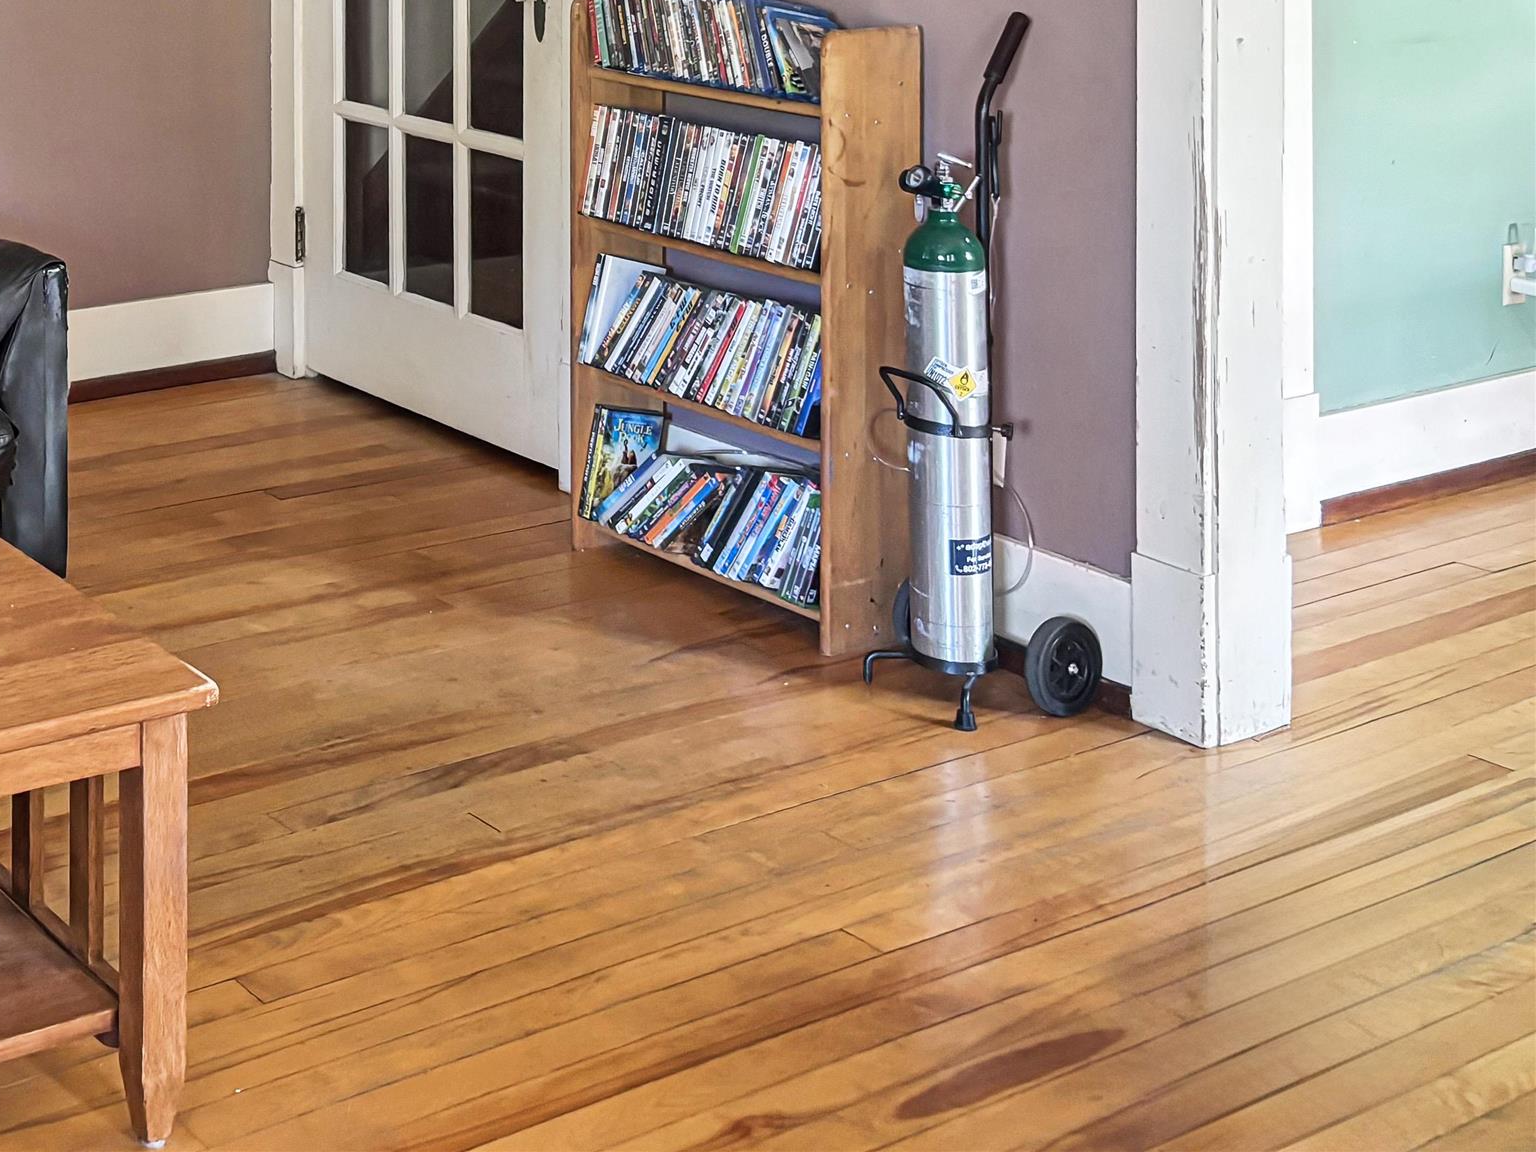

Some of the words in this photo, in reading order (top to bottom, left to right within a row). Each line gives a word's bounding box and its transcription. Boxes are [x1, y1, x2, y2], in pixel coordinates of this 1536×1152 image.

[760, 33, 773, 67] DOUBLE
[644, 140, 662, 216] SPIDER-MAN
[717, 159, 726, 182] BORN
[714, 183, 721, 194] TO
[709, 195, 718, 214] RIDE
[808, 351, 817, 368] PAIN
[801, 370, 811, 389] GAIN
[614, 418, 654, 436] JUNGLE
[807, 544, 820, 571] MAFIA
